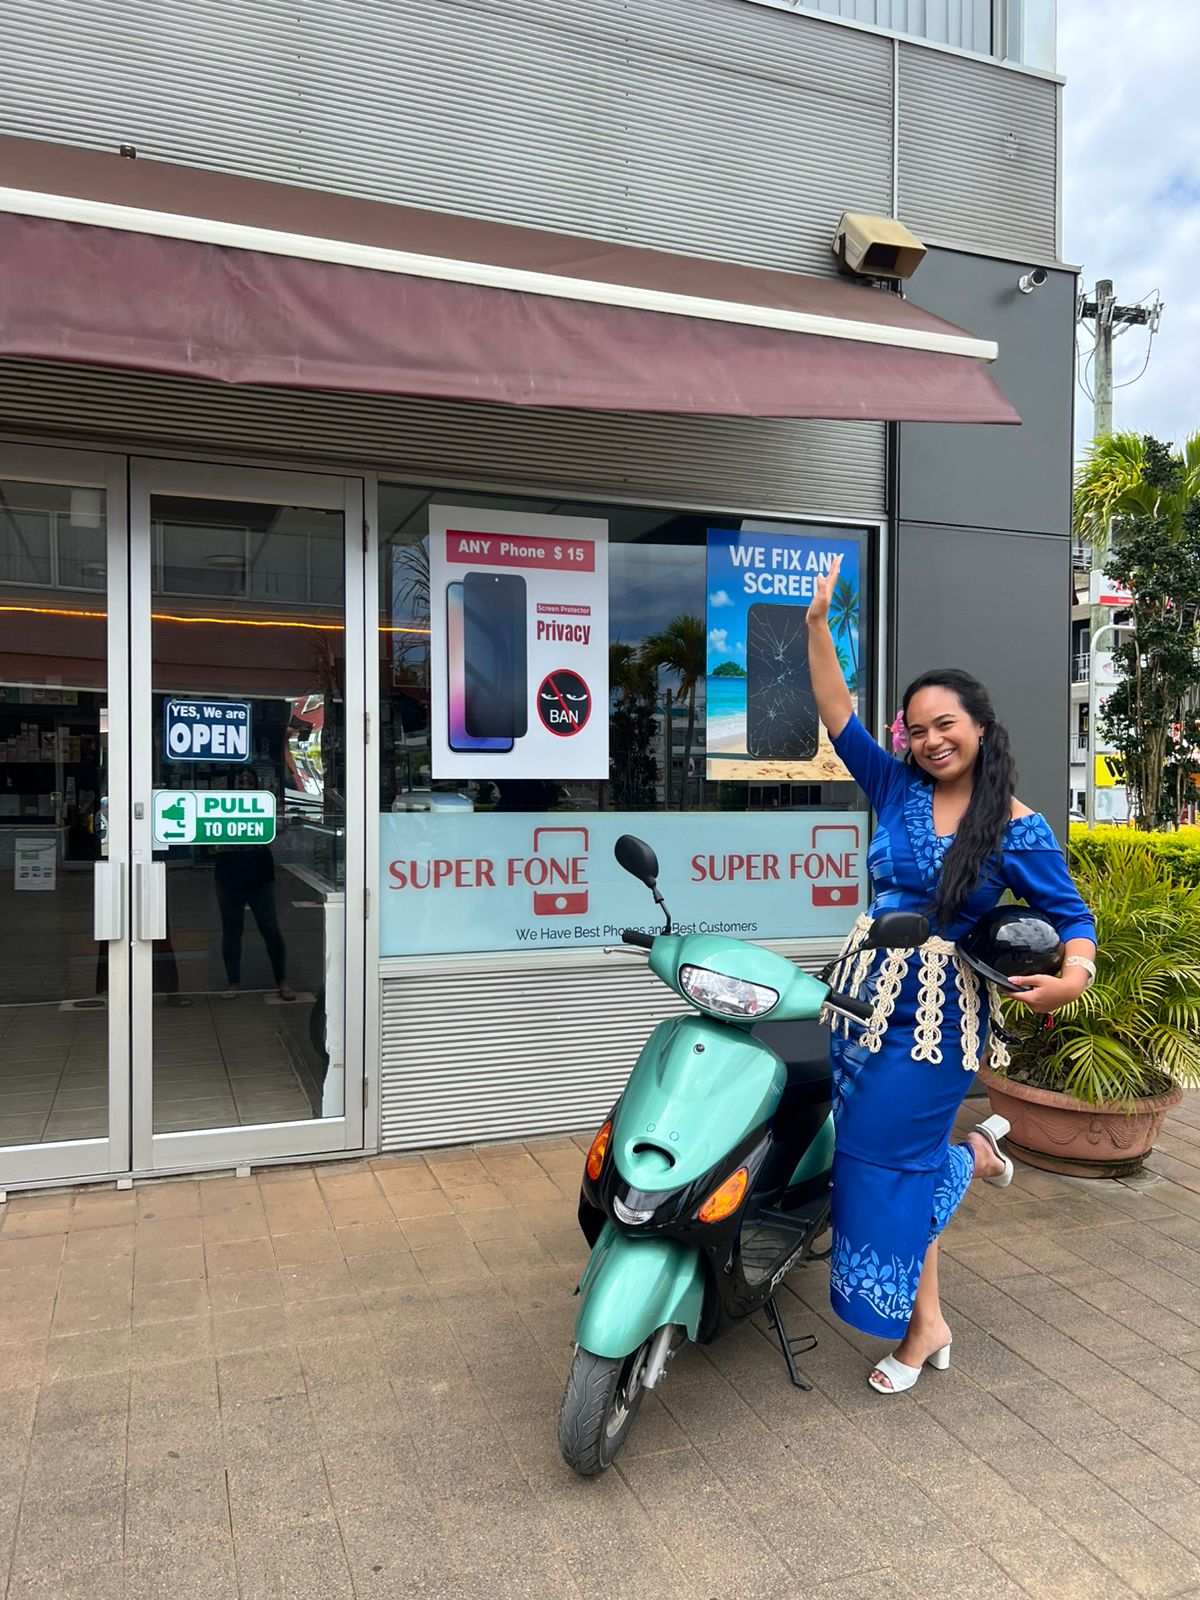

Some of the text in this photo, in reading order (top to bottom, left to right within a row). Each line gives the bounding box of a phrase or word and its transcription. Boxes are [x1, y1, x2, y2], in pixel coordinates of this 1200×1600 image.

[458, 539, 584, 561] ANY Phone $ 15
[729, 545, 766, 568] WE
[772, 547, 802, 571] FIX
[537, 620, 591, 645] Privacy
[171, 705, 246, 720] YES, We are
[550, 709, 579, 723] BAN
[169, 722, 247, 754] OPEN
[204, 797, 265, 813] PULL
[204, 821, 264, 837] TO OPEN
[388, 857, 589, 890] SUPER FONE
[691, 852, 859, 882] SUPER FONE
[516, 928, 537, 940] We
[540, 927, 571, 940] Have
[574, 925, 600, 938] Best
[672, 922, 696, 935] Best
[700, 920, 758, 933] Customers
